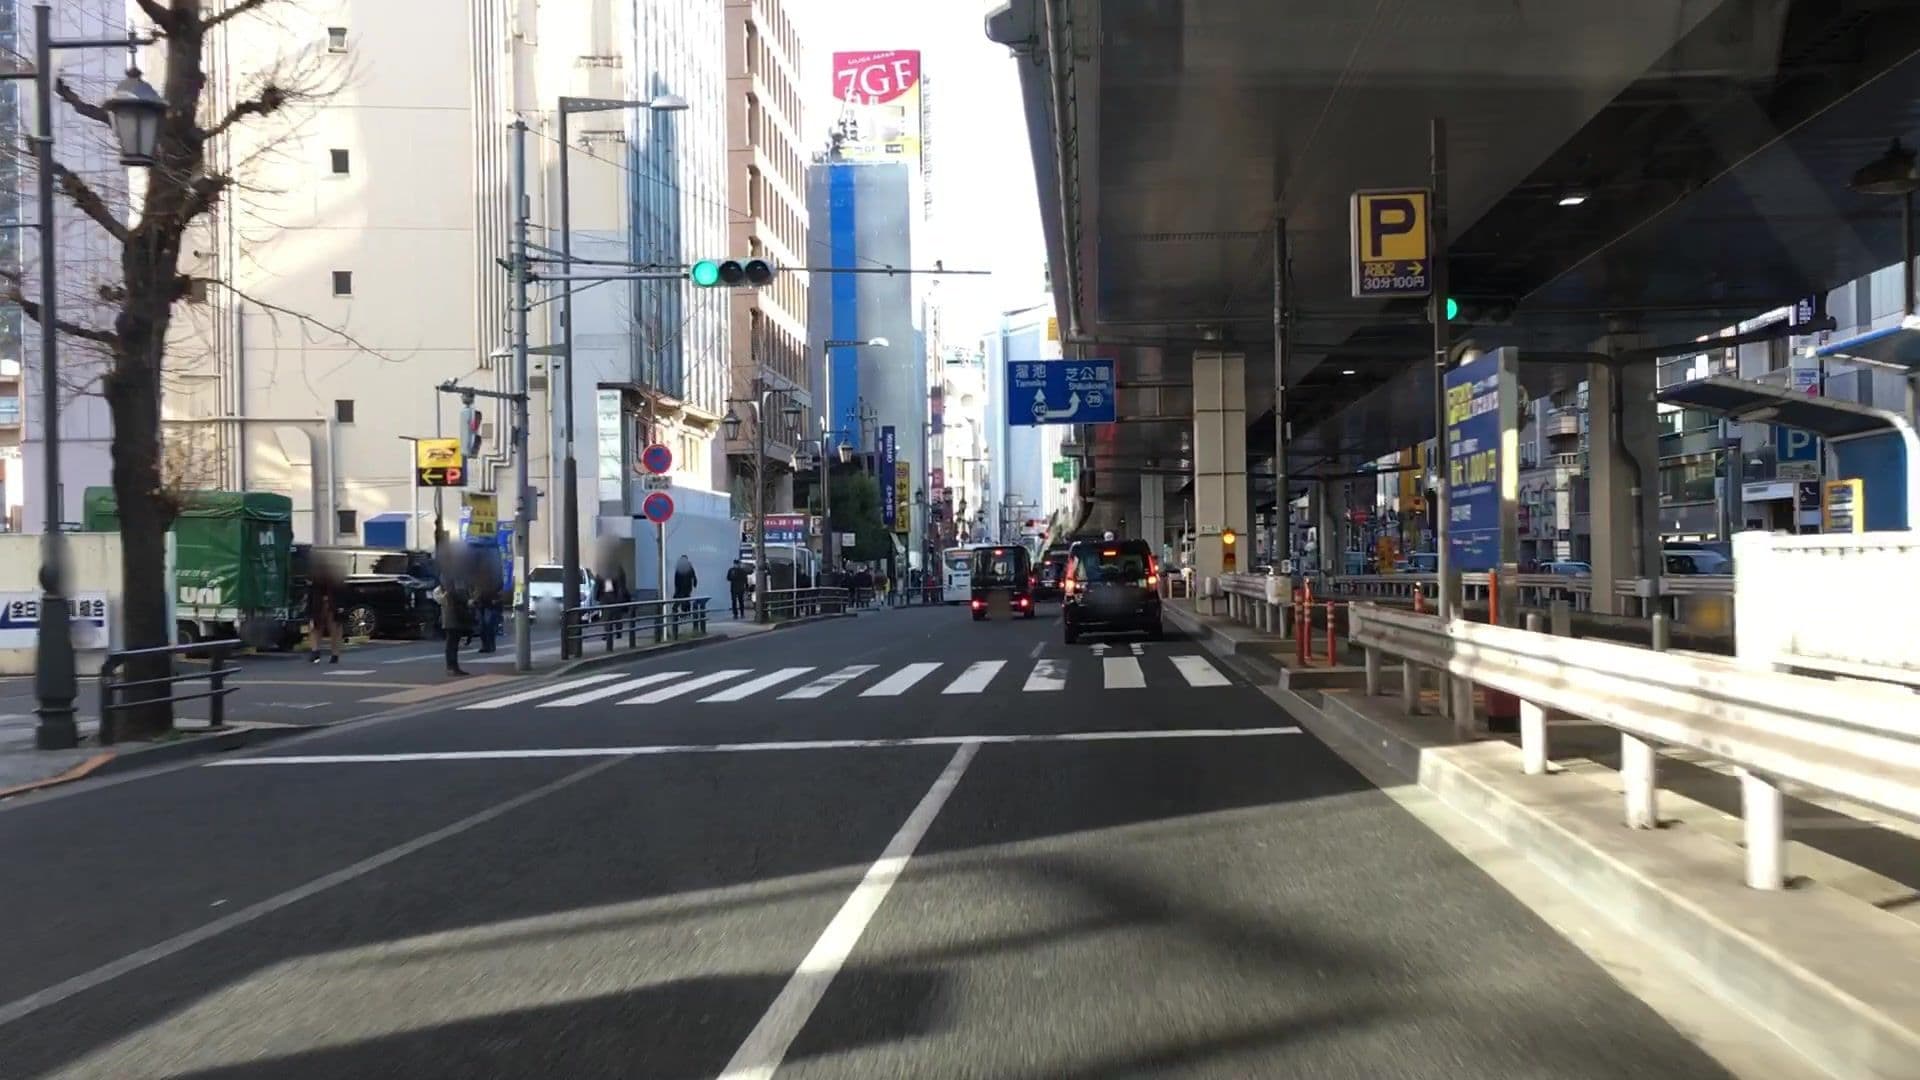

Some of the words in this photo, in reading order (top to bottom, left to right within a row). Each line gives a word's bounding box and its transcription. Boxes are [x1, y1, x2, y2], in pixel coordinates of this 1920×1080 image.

[838, 59, 911, 96] 7GF
[1370, 198, 1416, 257] P
[1065, 367, 1109, 381] 芝公園
[1787, 429, 1810, 458] P
[446, 469, 462, 484] P
